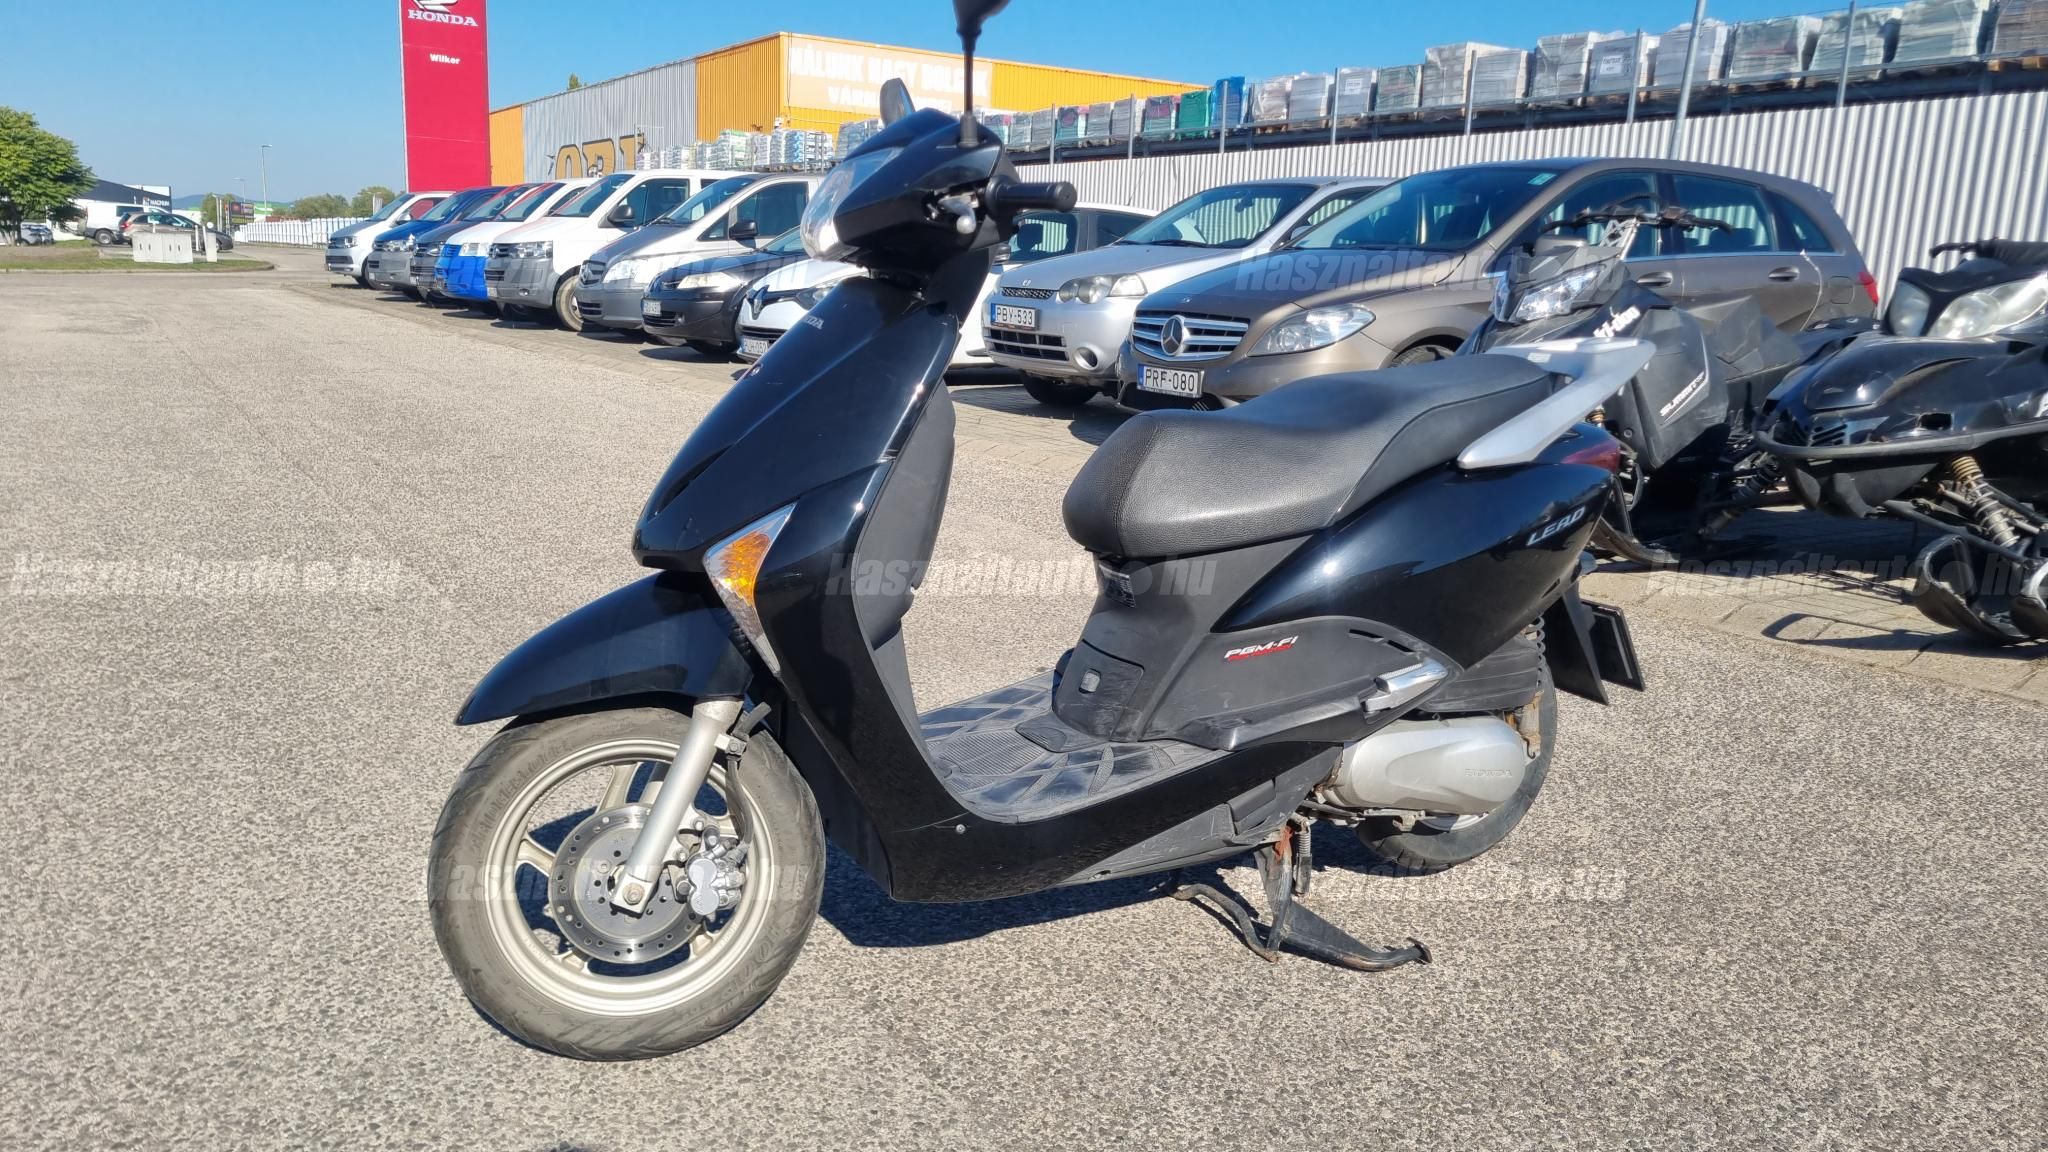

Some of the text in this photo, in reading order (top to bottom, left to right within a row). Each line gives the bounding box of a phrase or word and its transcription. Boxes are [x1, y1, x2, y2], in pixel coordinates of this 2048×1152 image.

[408, 9, 479, 27] HONDA
[430, 53, 460, 65] Wilker
[996, 306, 1033, 326] PBY-533
[1145, 368, 1195, 392] PRF-080
[1526, 506, 1586, 547] LEAD
[1224, 635, 1299, 659] PGM-FI
